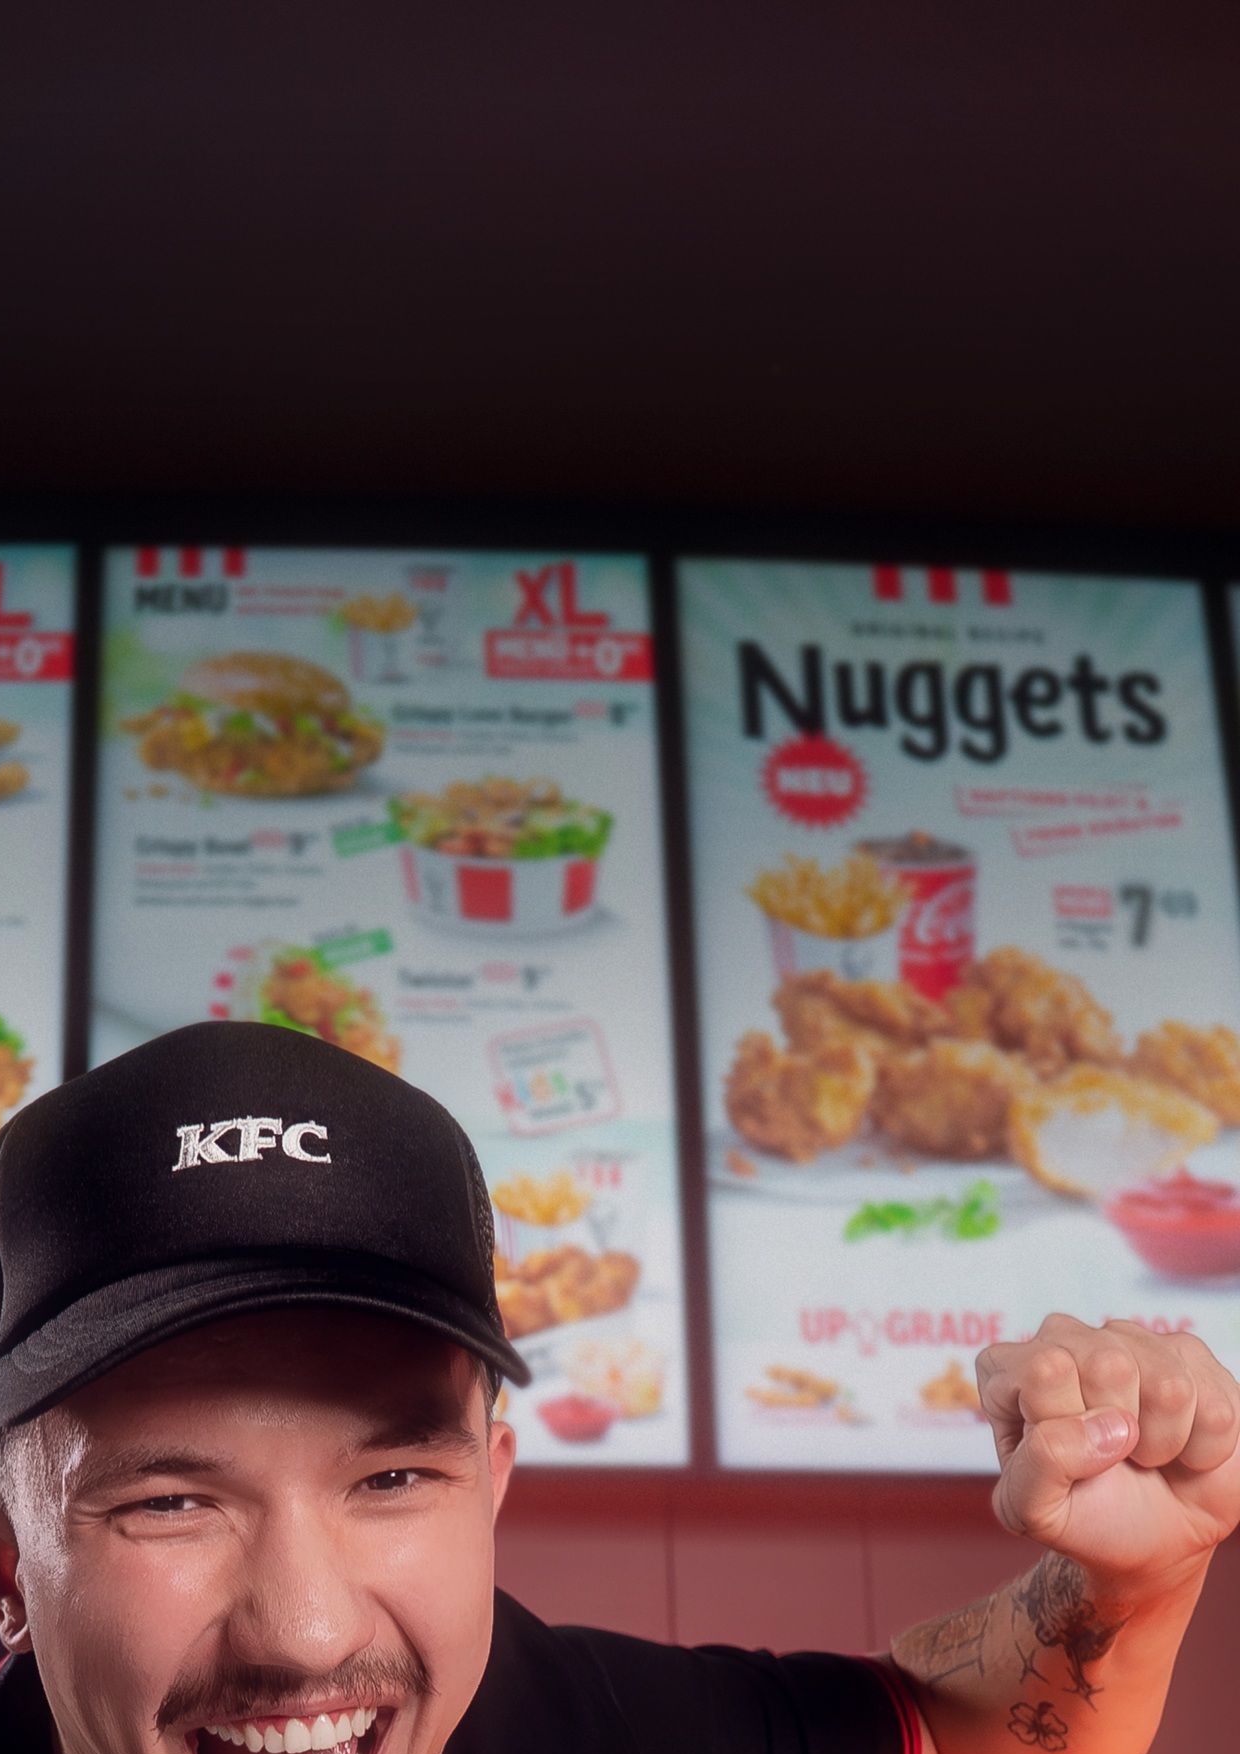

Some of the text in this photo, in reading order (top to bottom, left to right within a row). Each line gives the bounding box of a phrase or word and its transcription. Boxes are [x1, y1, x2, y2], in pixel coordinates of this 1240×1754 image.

[512, 561, 610, 629] XL
[737, 640, 1168, 763] Nuggets
[172, 1115, 332, 1172] KFC
